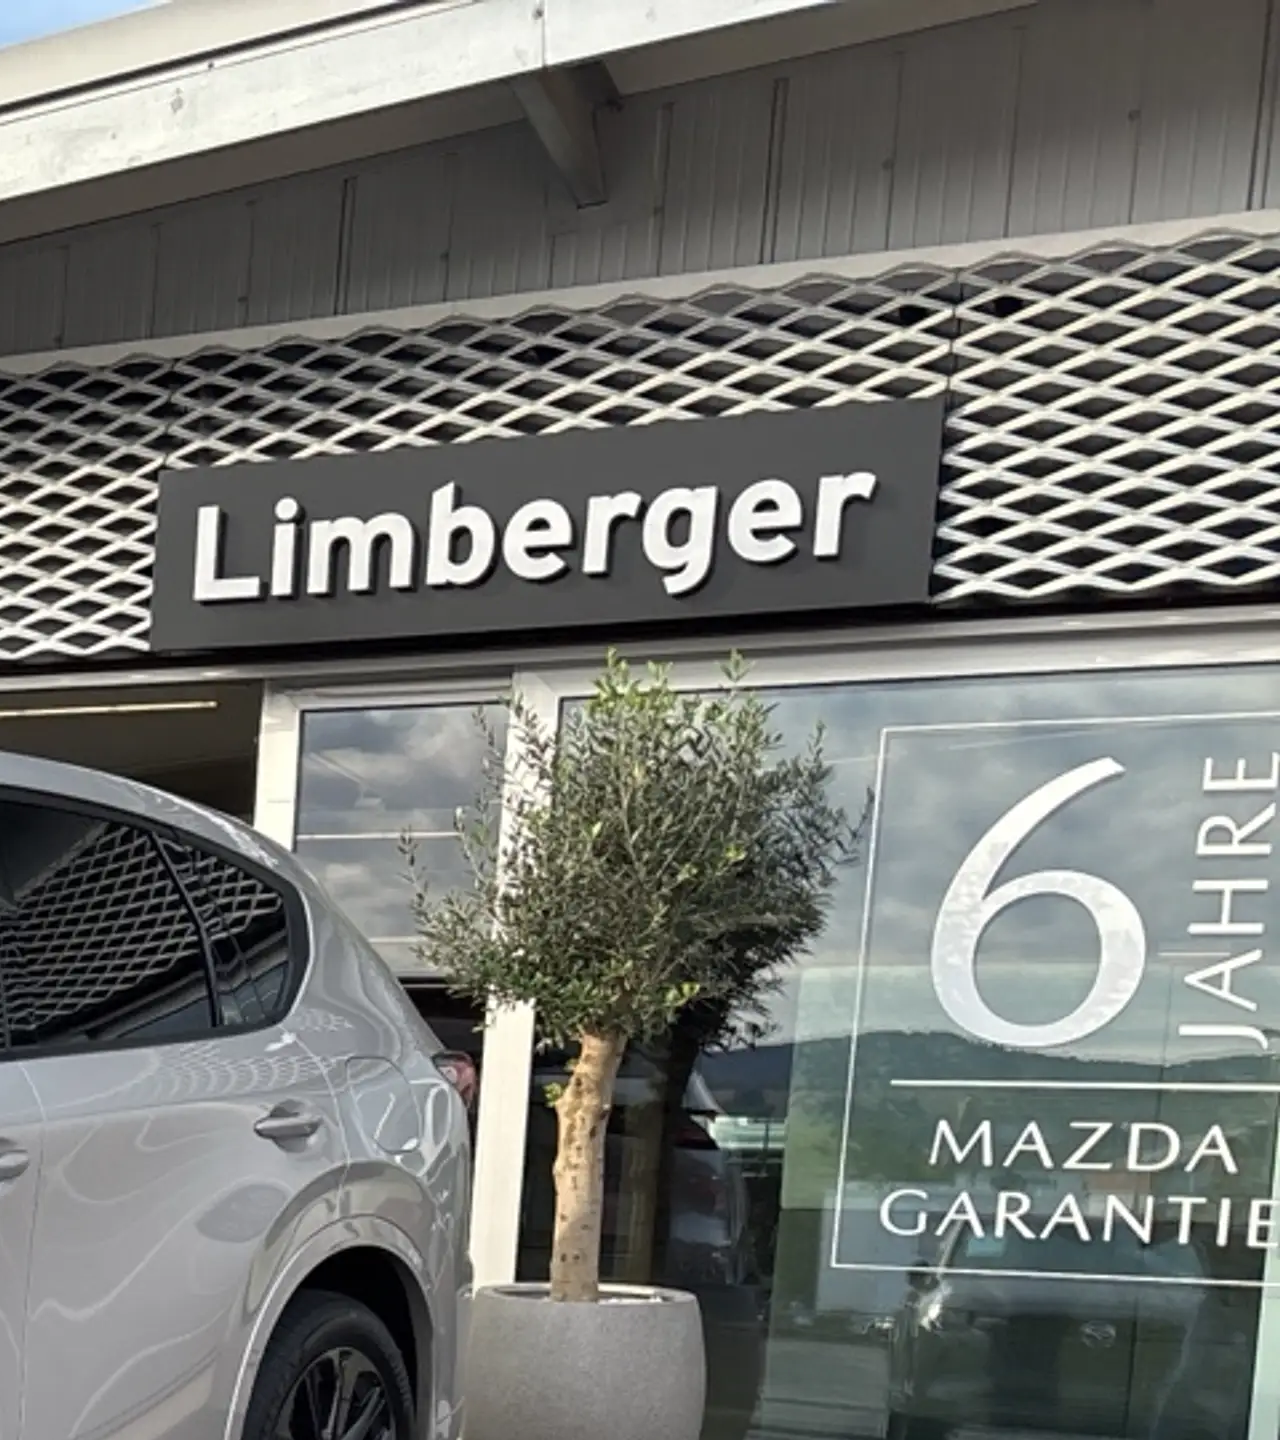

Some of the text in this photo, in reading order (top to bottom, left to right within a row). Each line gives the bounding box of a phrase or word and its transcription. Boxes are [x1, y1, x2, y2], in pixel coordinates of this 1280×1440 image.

[193, 470, 877, 602] Limberger
[930, 756, 1146, 1047] 6
[1178, 751, 1280, 1050] JAHRE
[928, 1119, 1239, 1175] MAZDA
[879, 1188, 1280, 1248] GARANTIE
